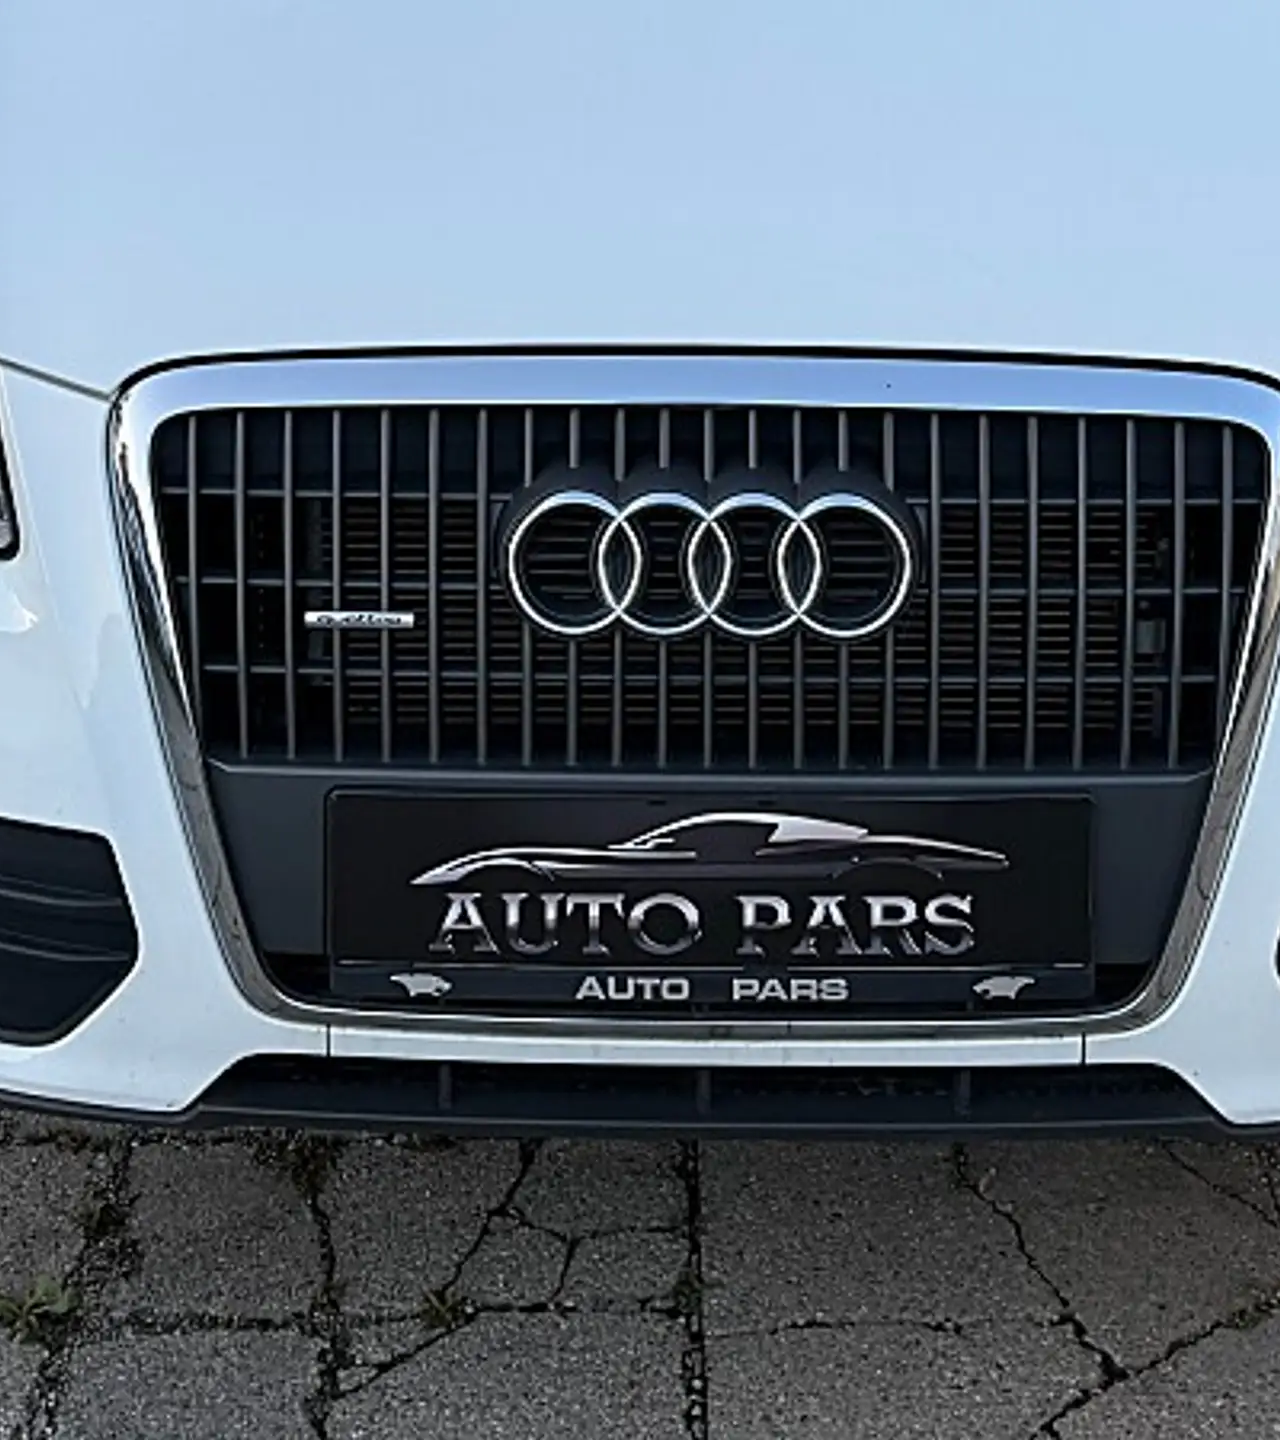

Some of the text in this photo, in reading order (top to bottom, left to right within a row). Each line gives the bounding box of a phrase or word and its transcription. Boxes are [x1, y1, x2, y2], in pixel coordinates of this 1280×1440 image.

[428, 891, 975, 957] AUTO PARS
[575, 976, 850, 1001] AUTO PARS
